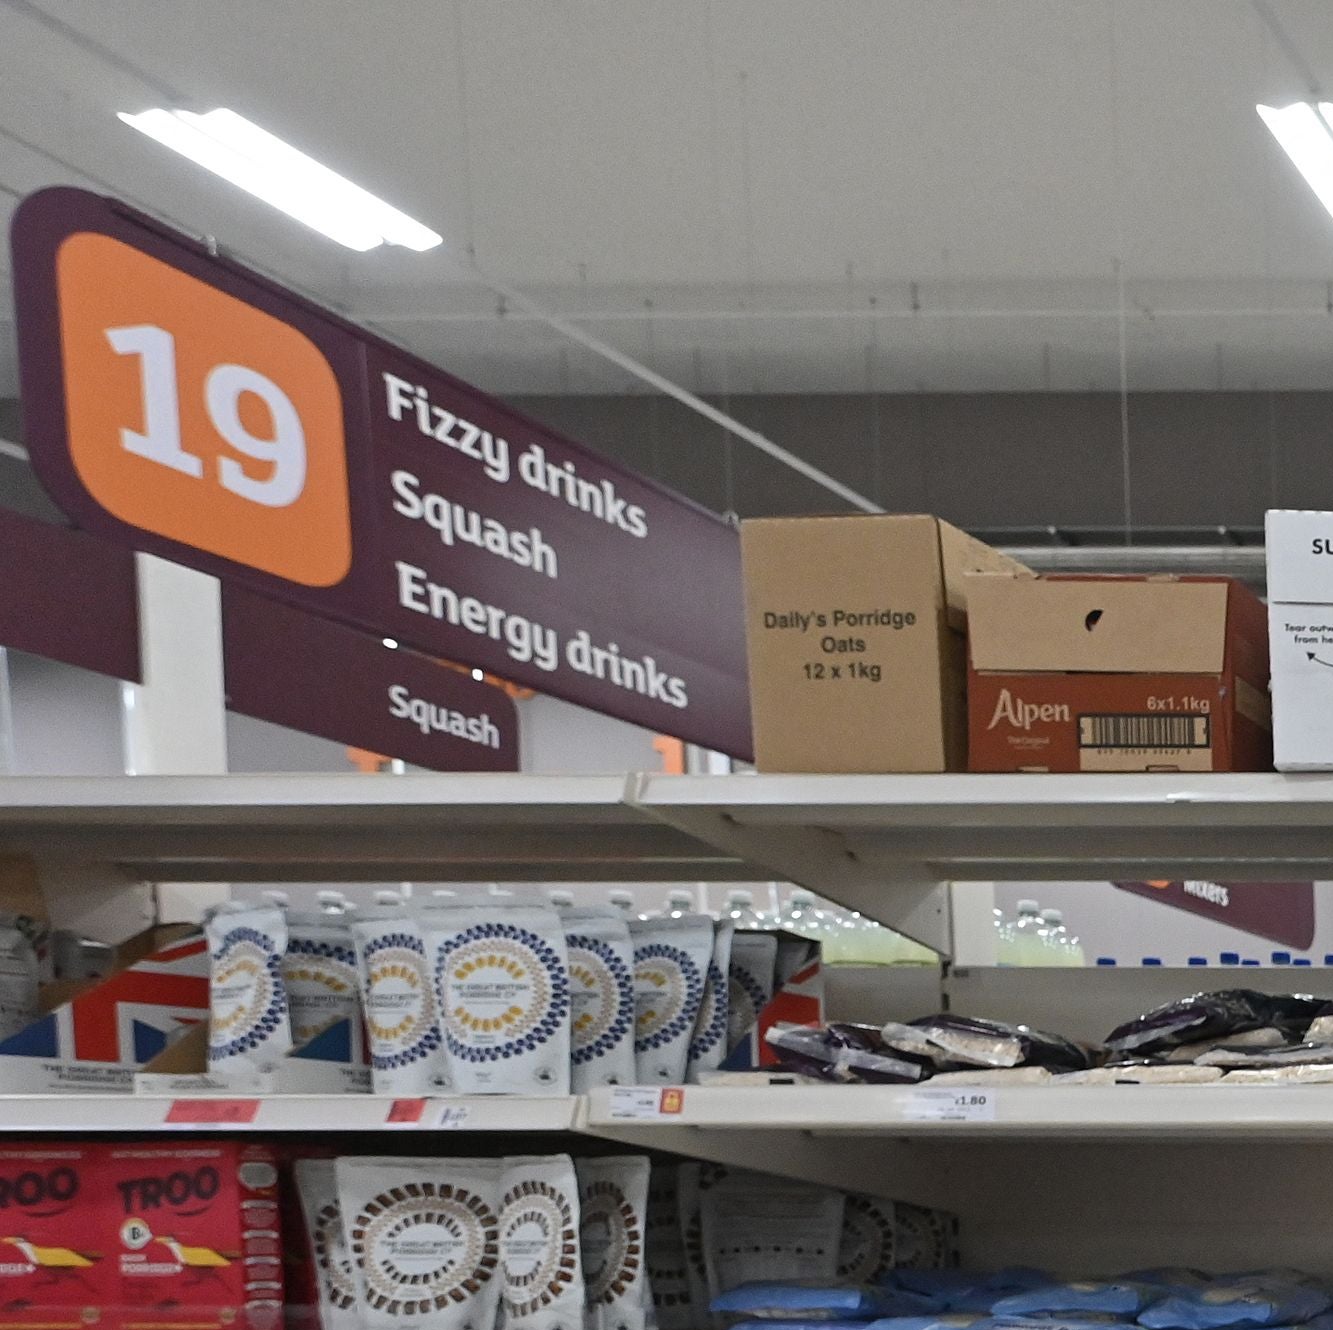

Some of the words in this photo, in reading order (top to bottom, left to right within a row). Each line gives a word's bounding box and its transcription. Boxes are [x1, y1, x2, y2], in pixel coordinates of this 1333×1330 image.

[104, 324, 308, 508] 19
[382, 372, 511, 482] Fizzy
[519, 444, 649, 539] drinks
[391, 470, 558, 579] Squash
[395, 562, 558, 671] Energy
[566, 630, 689, 709] drinks
[832, 608, 917, 631] Porridge
[821, 636, 867, 653] Oats
[803, 663, 825, 681] 12
[830, 667, 842, 680] x
[848, 662, 882, 683] 1kg
[388, 685, 500, 749] Squash
[988, 688, 1071, 731] Alpen
[1146, 696, 1211, 714] 6x1.1kg
[117, 1166, 221, 1214] TROO
